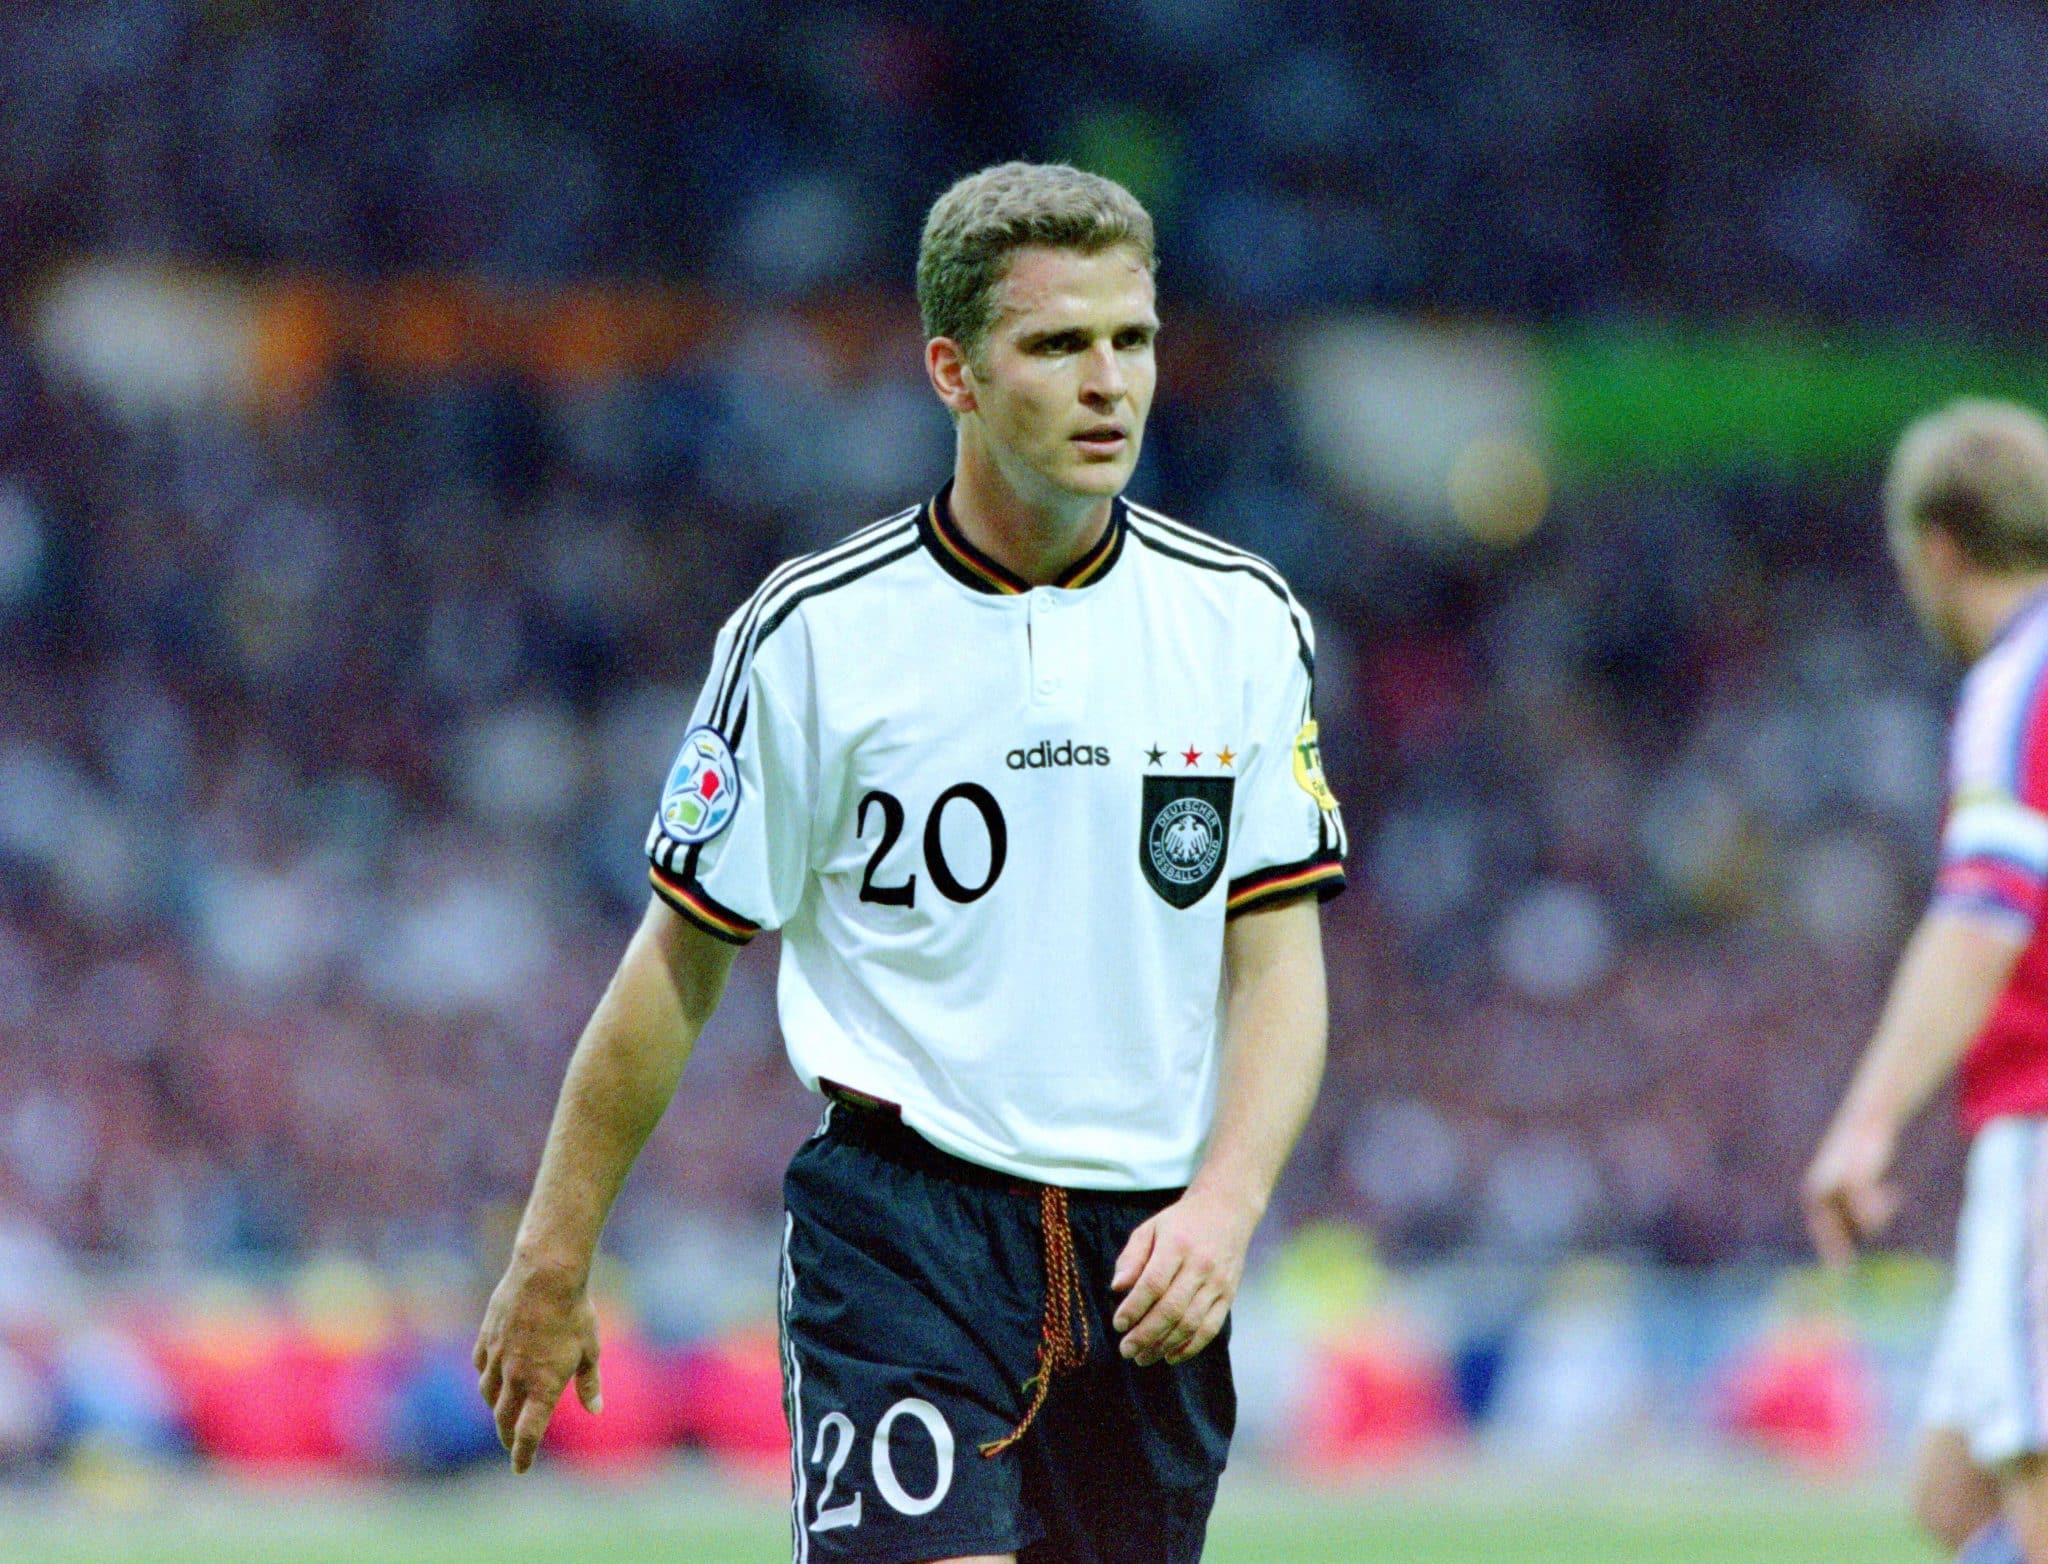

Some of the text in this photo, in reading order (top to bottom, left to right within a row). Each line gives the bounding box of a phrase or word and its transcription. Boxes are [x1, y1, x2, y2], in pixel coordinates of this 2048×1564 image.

[1006, 739, 1110, 770] adidas
[1157, 800, 1219, 828] DEUTSCHER
[857, 782, 1007, 908] 20
[1152, 839, 1219, 880] FUSSBALL-BUND
[809, 1398, 954, 1532] 20
